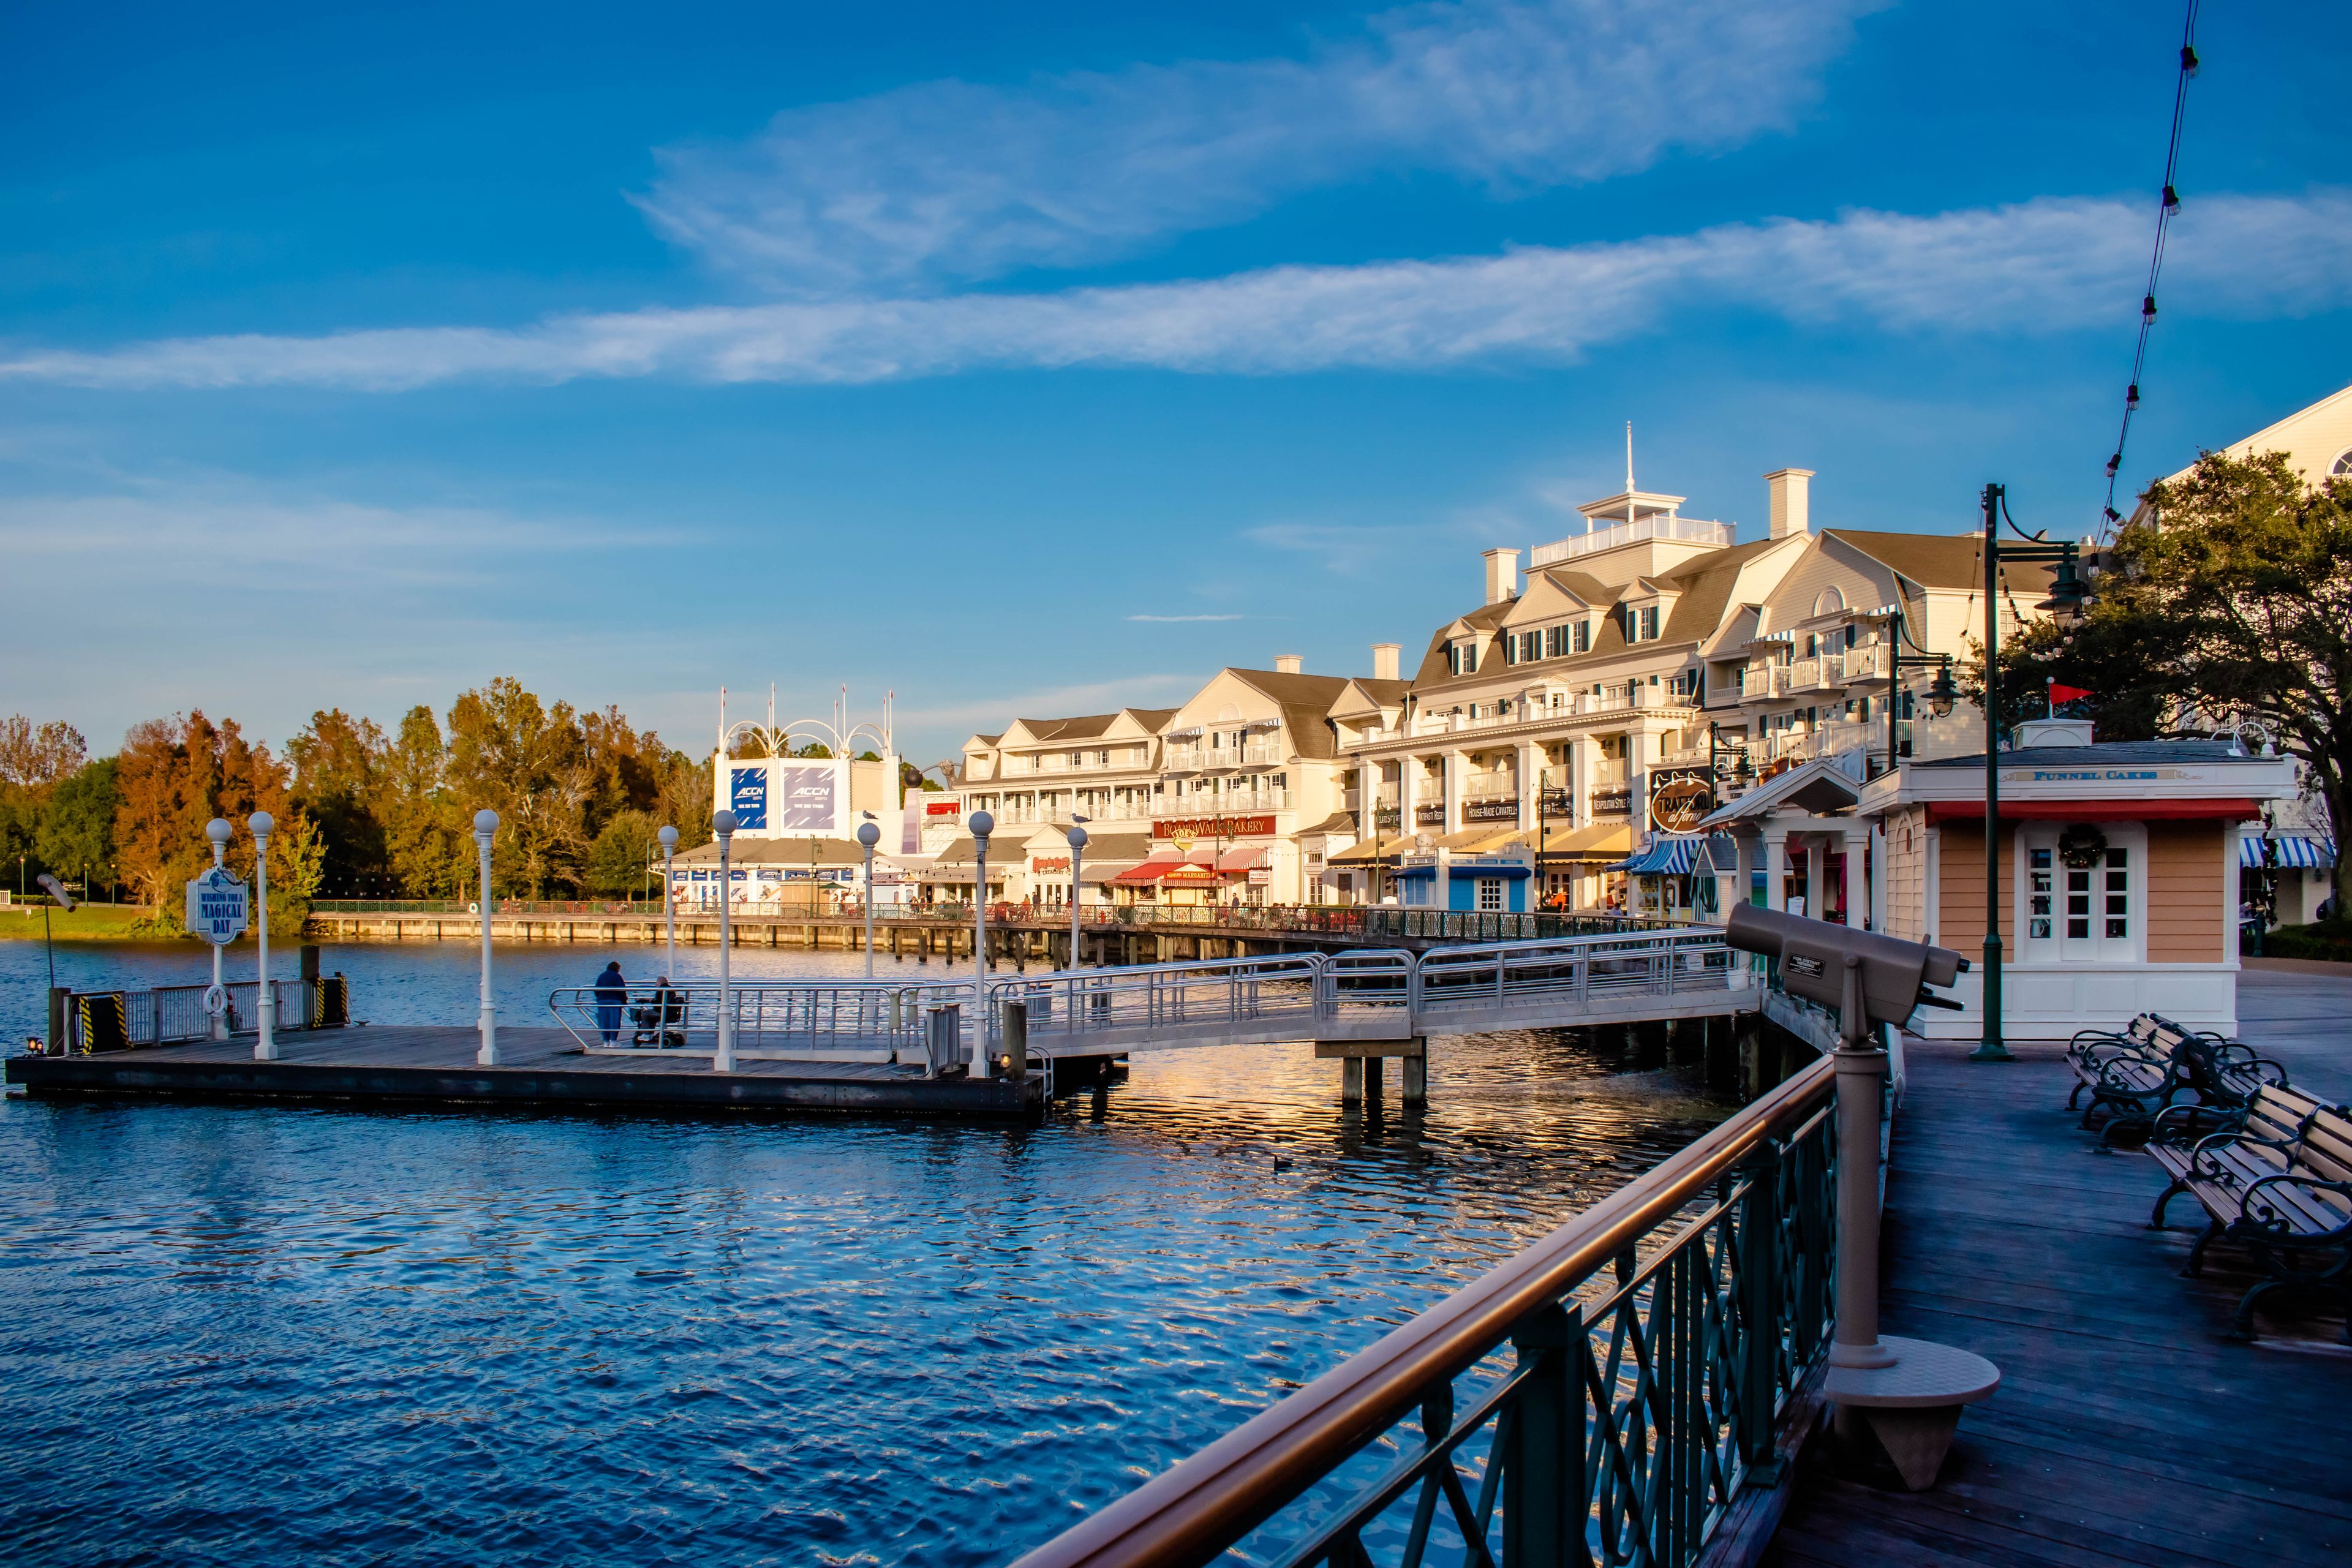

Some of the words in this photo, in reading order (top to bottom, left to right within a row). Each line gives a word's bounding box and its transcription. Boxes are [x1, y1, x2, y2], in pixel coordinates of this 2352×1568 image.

[2033, 771, 2101, 781] FUNNEL
[2106, 770, 2158, 780] CAKES
[737, 786, 764, 796] ACCN
[793, 787, 830, 796] ACCN
[1538, 803, 1551, 813] SPER
[1593, 799, 1615, 810] NEAPOLITAN
[1659, 793, 1710, 813] TRATTORI
[1417, 811, 1434, 821] ANTIPASTI
[1468, 806, 1495, 818] HOUSE-MADE
[1227, 820, 1265, 834] BAKERY
[1175, 829, 1196, 839] JOE'S
[201, 893, 227, 902] WISHING
[238, 893, 243, 902] A
[201, 903, 243, 918] MAGICAL
[213, 919, 231, 933] DAY
